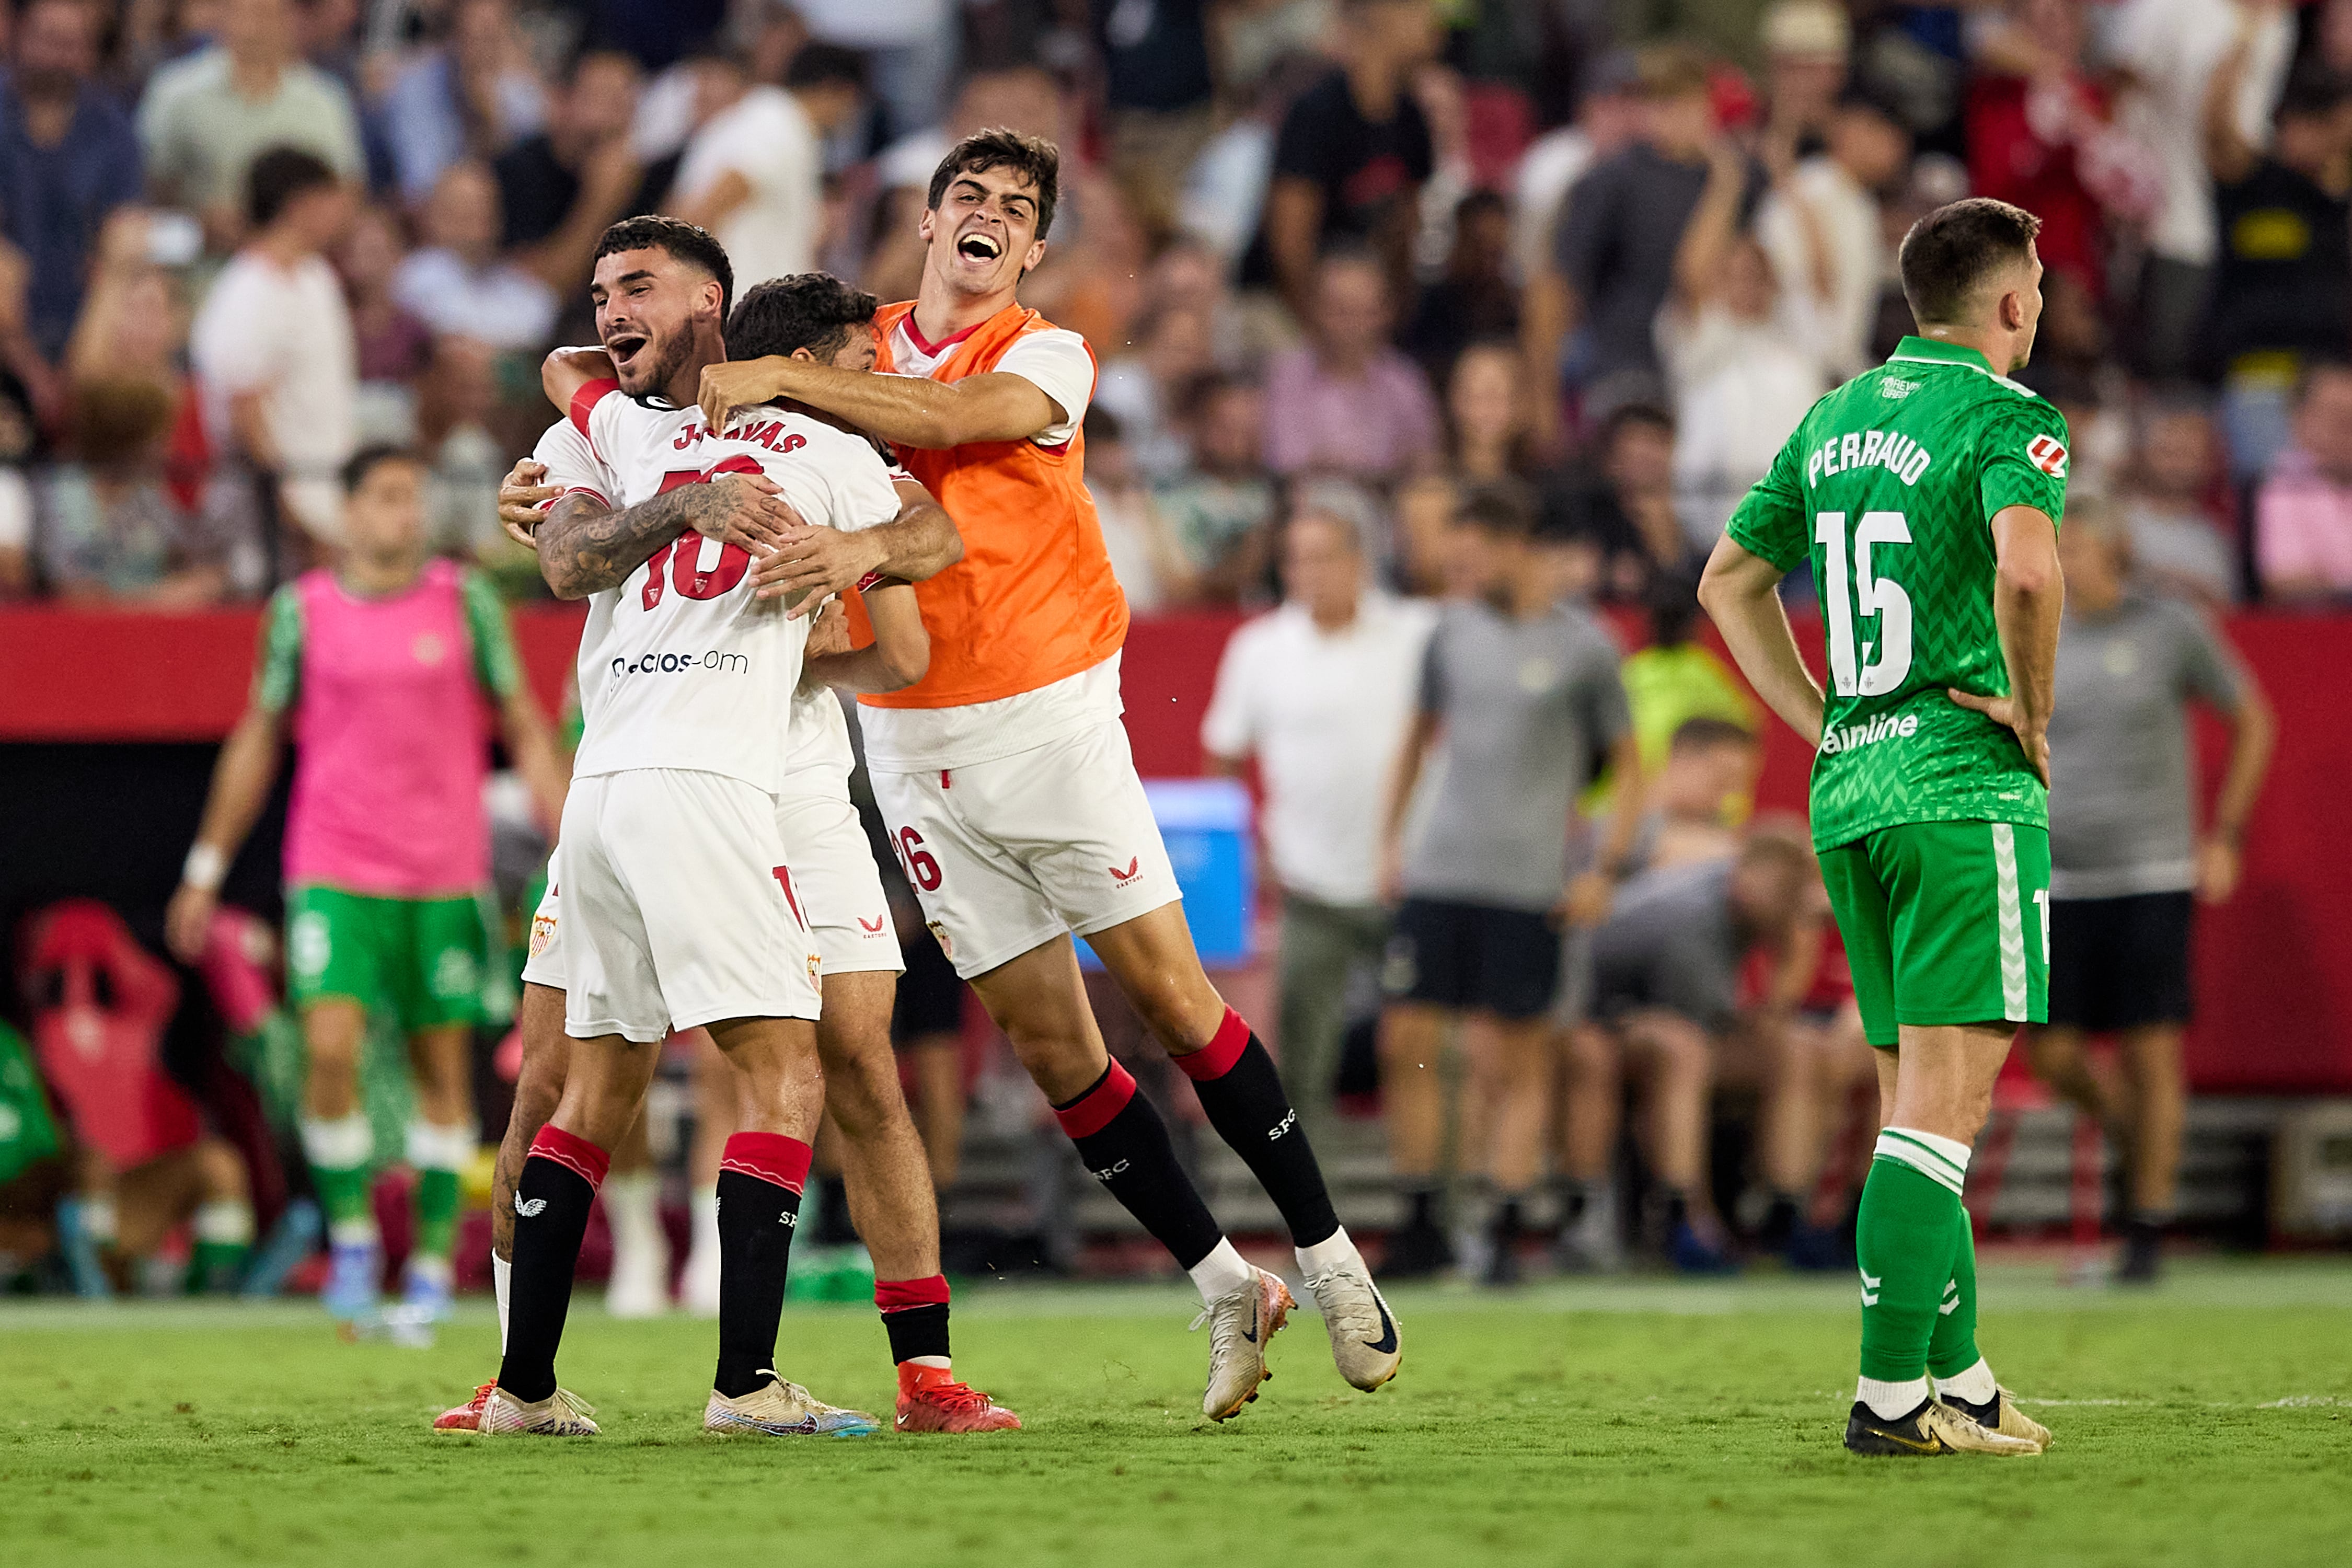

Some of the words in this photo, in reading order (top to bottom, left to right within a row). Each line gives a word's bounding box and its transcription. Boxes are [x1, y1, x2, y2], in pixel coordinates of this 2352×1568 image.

[1808, 430, 1931, 489] PERRAUD
[1815, 511, 1913, 697] 15
[1267, 1108, 1296, 1141] SFC
